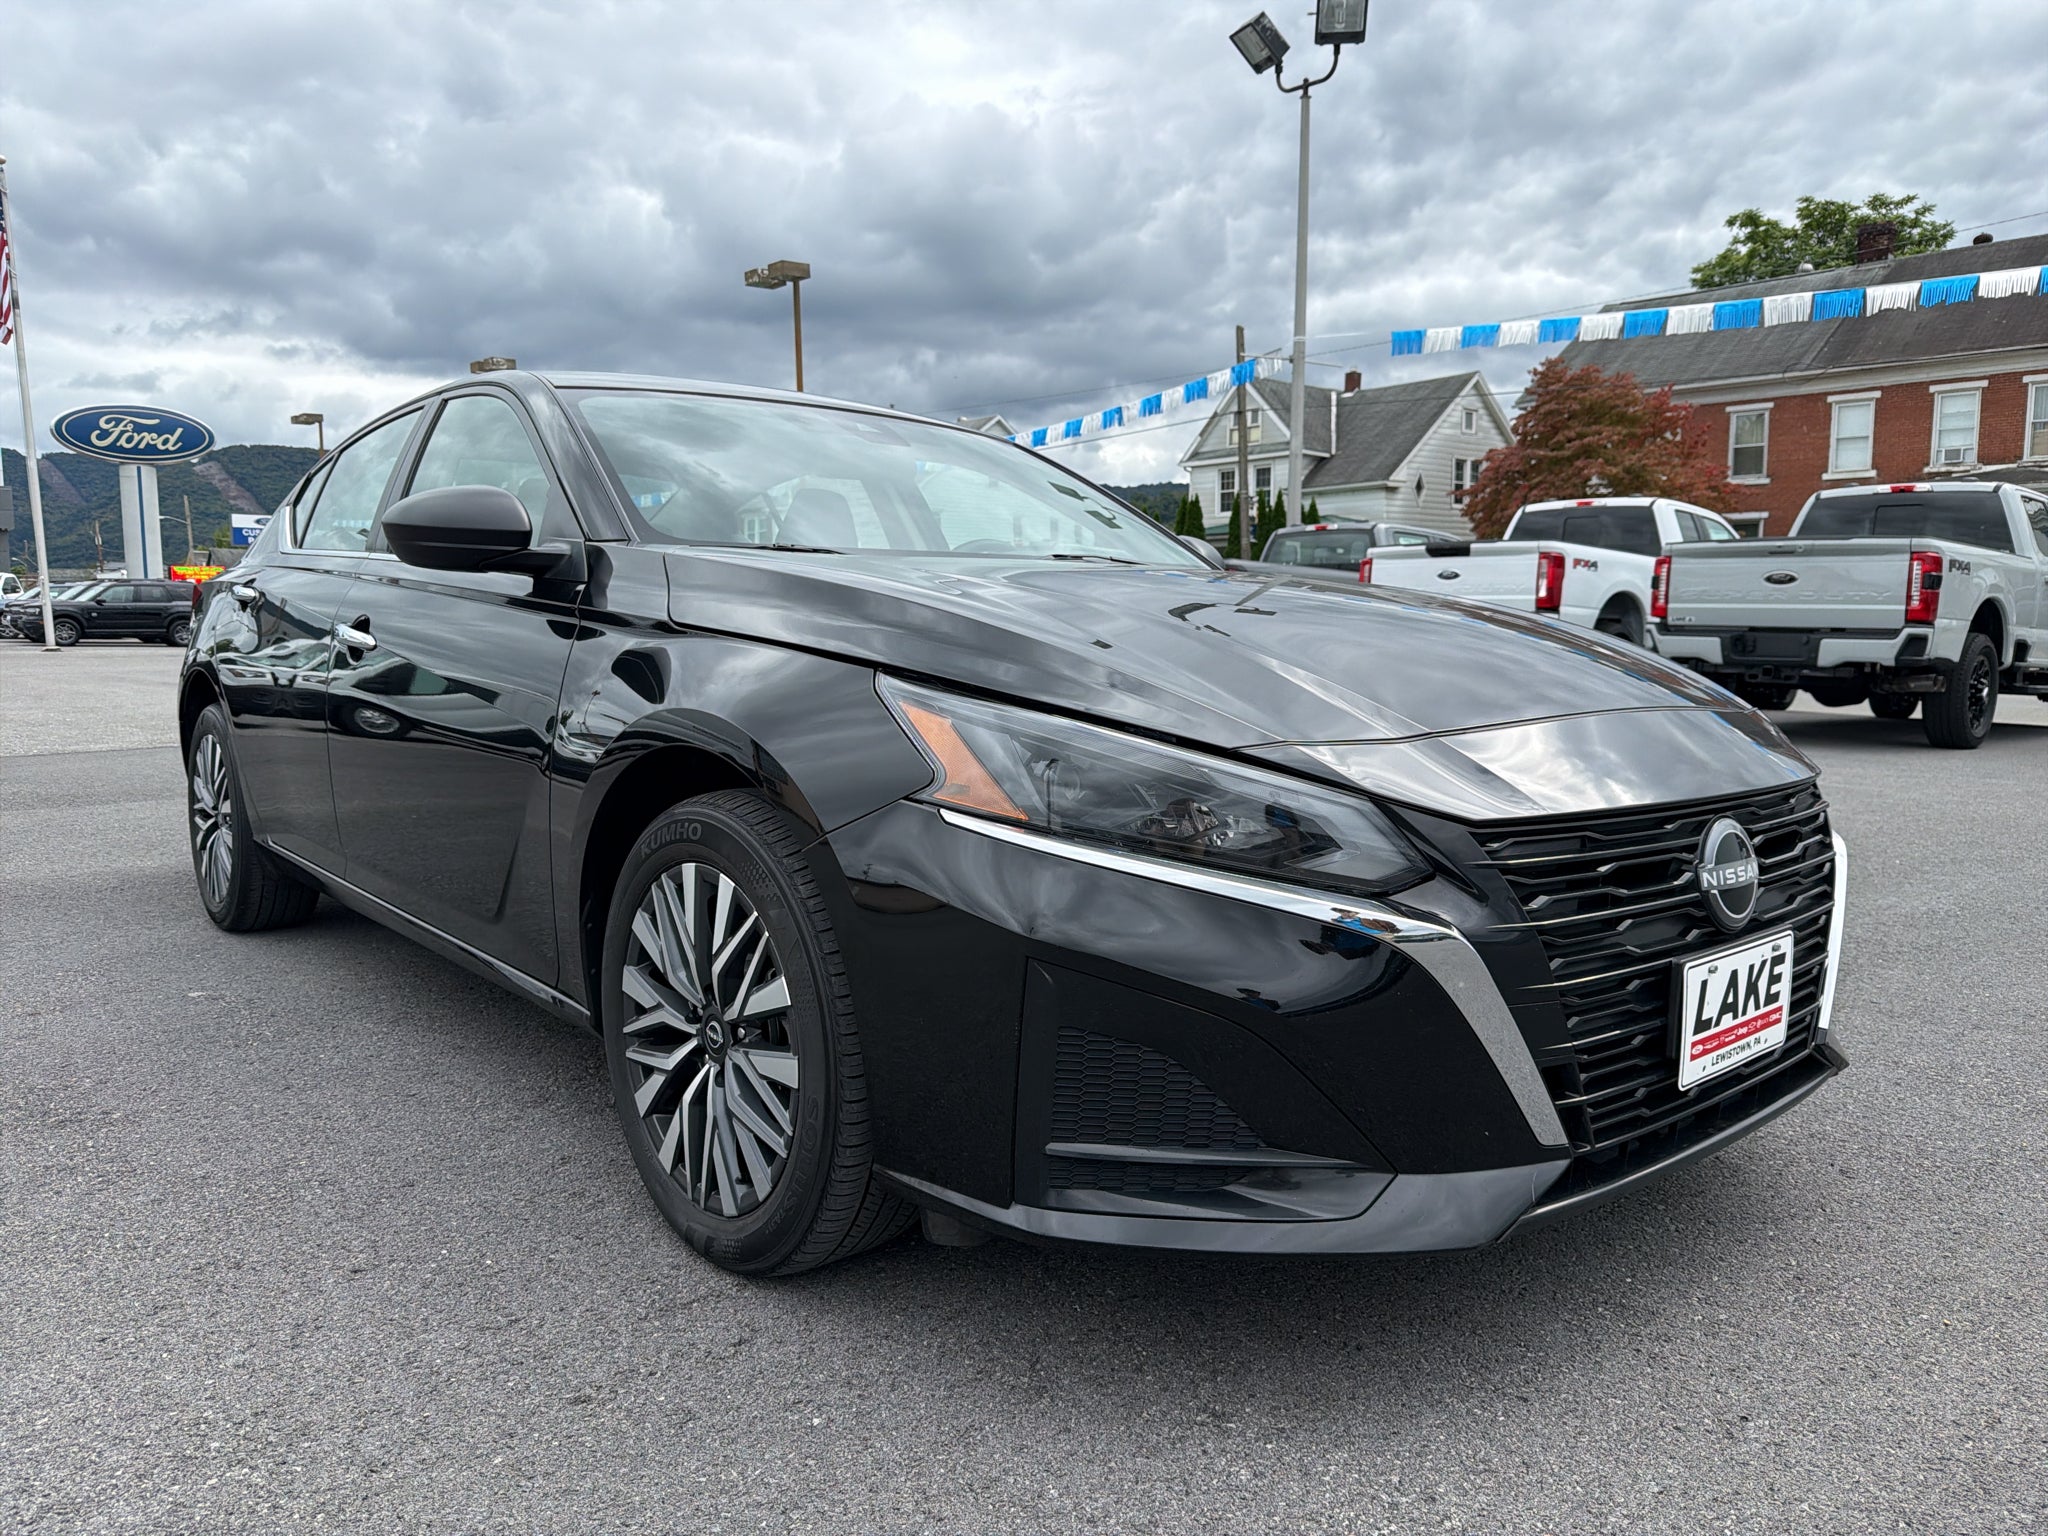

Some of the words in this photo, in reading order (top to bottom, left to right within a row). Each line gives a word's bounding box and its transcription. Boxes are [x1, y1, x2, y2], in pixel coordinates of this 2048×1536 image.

[90, 414, 184, 452] Ford
[1573, 558, 1598, 571] FX4
[1948, 559, 1971, 574] FX4
[640, 822, 702, 859] KUMHO
[1702, 862, 1759, 888] NISSAN
[1692, 951, 1787, 1036] LAKE
[1753, 1035, 1762, 1048] PA
